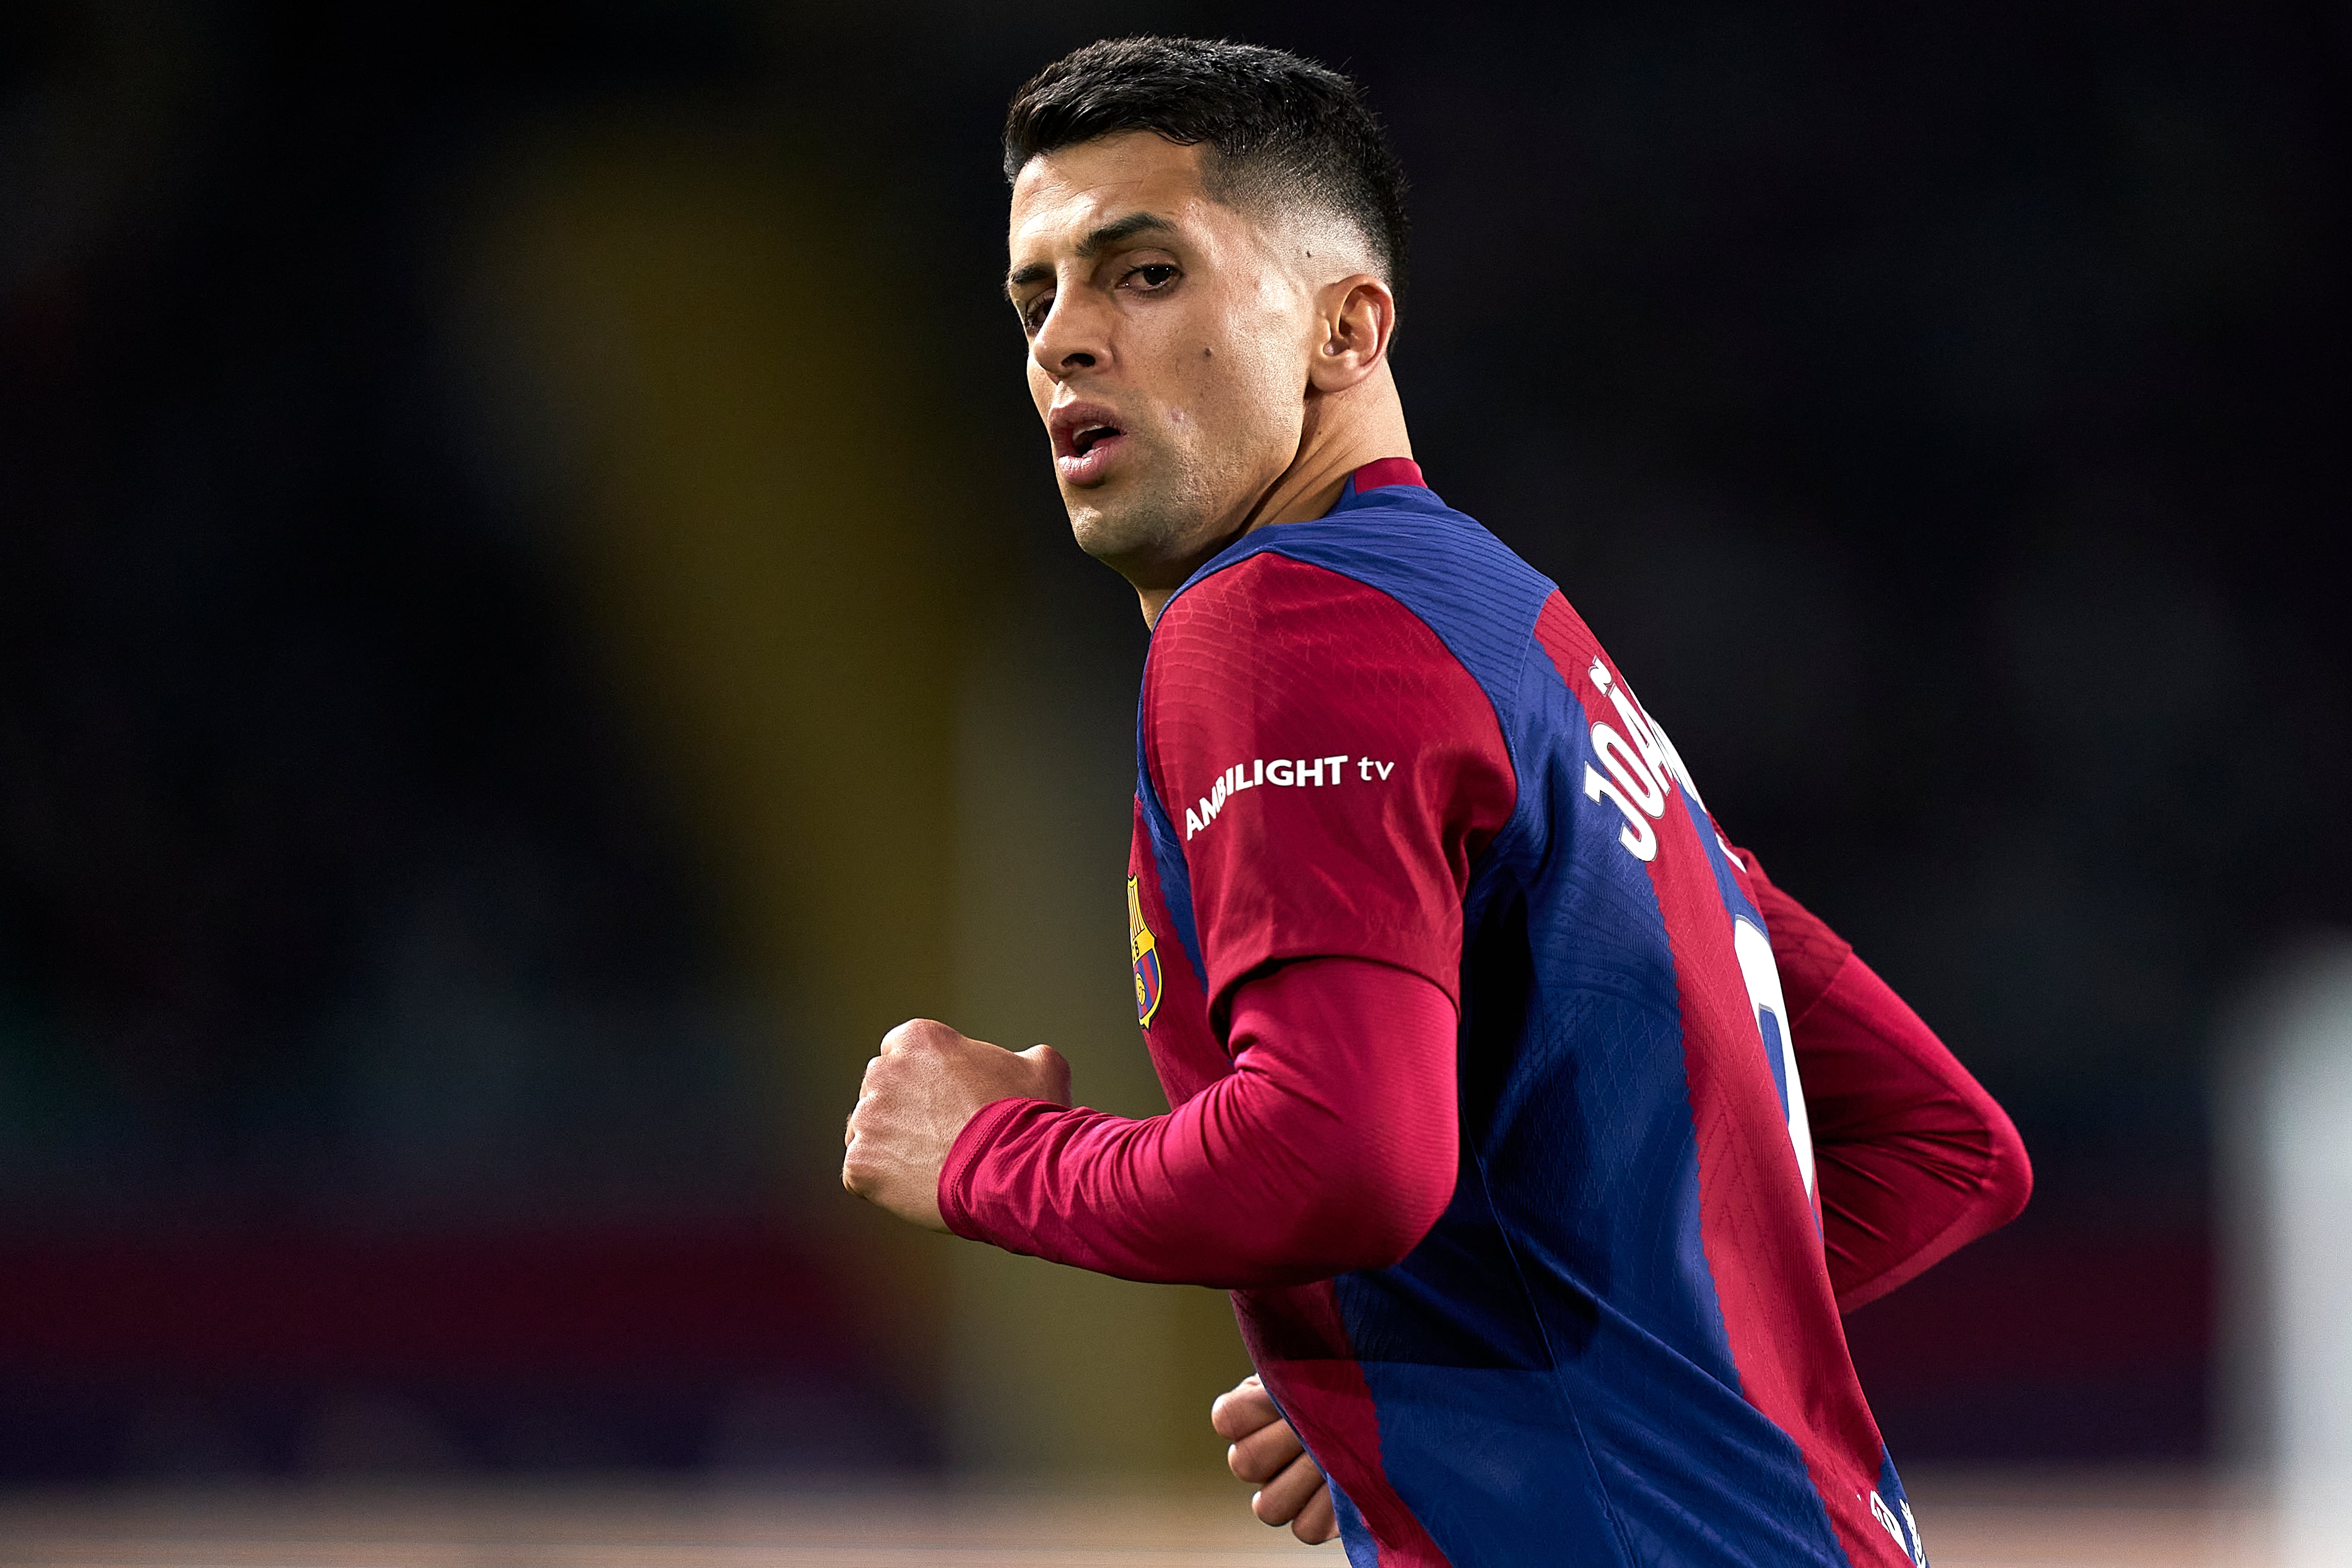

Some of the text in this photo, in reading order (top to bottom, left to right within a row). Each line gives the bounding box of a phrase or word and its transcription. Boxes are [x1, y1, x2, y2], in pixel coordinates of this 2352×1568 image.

[1185, 755, 1394, 841] AMBILIGHT tv
[1583, 654, 1681, 862] JOÃ
